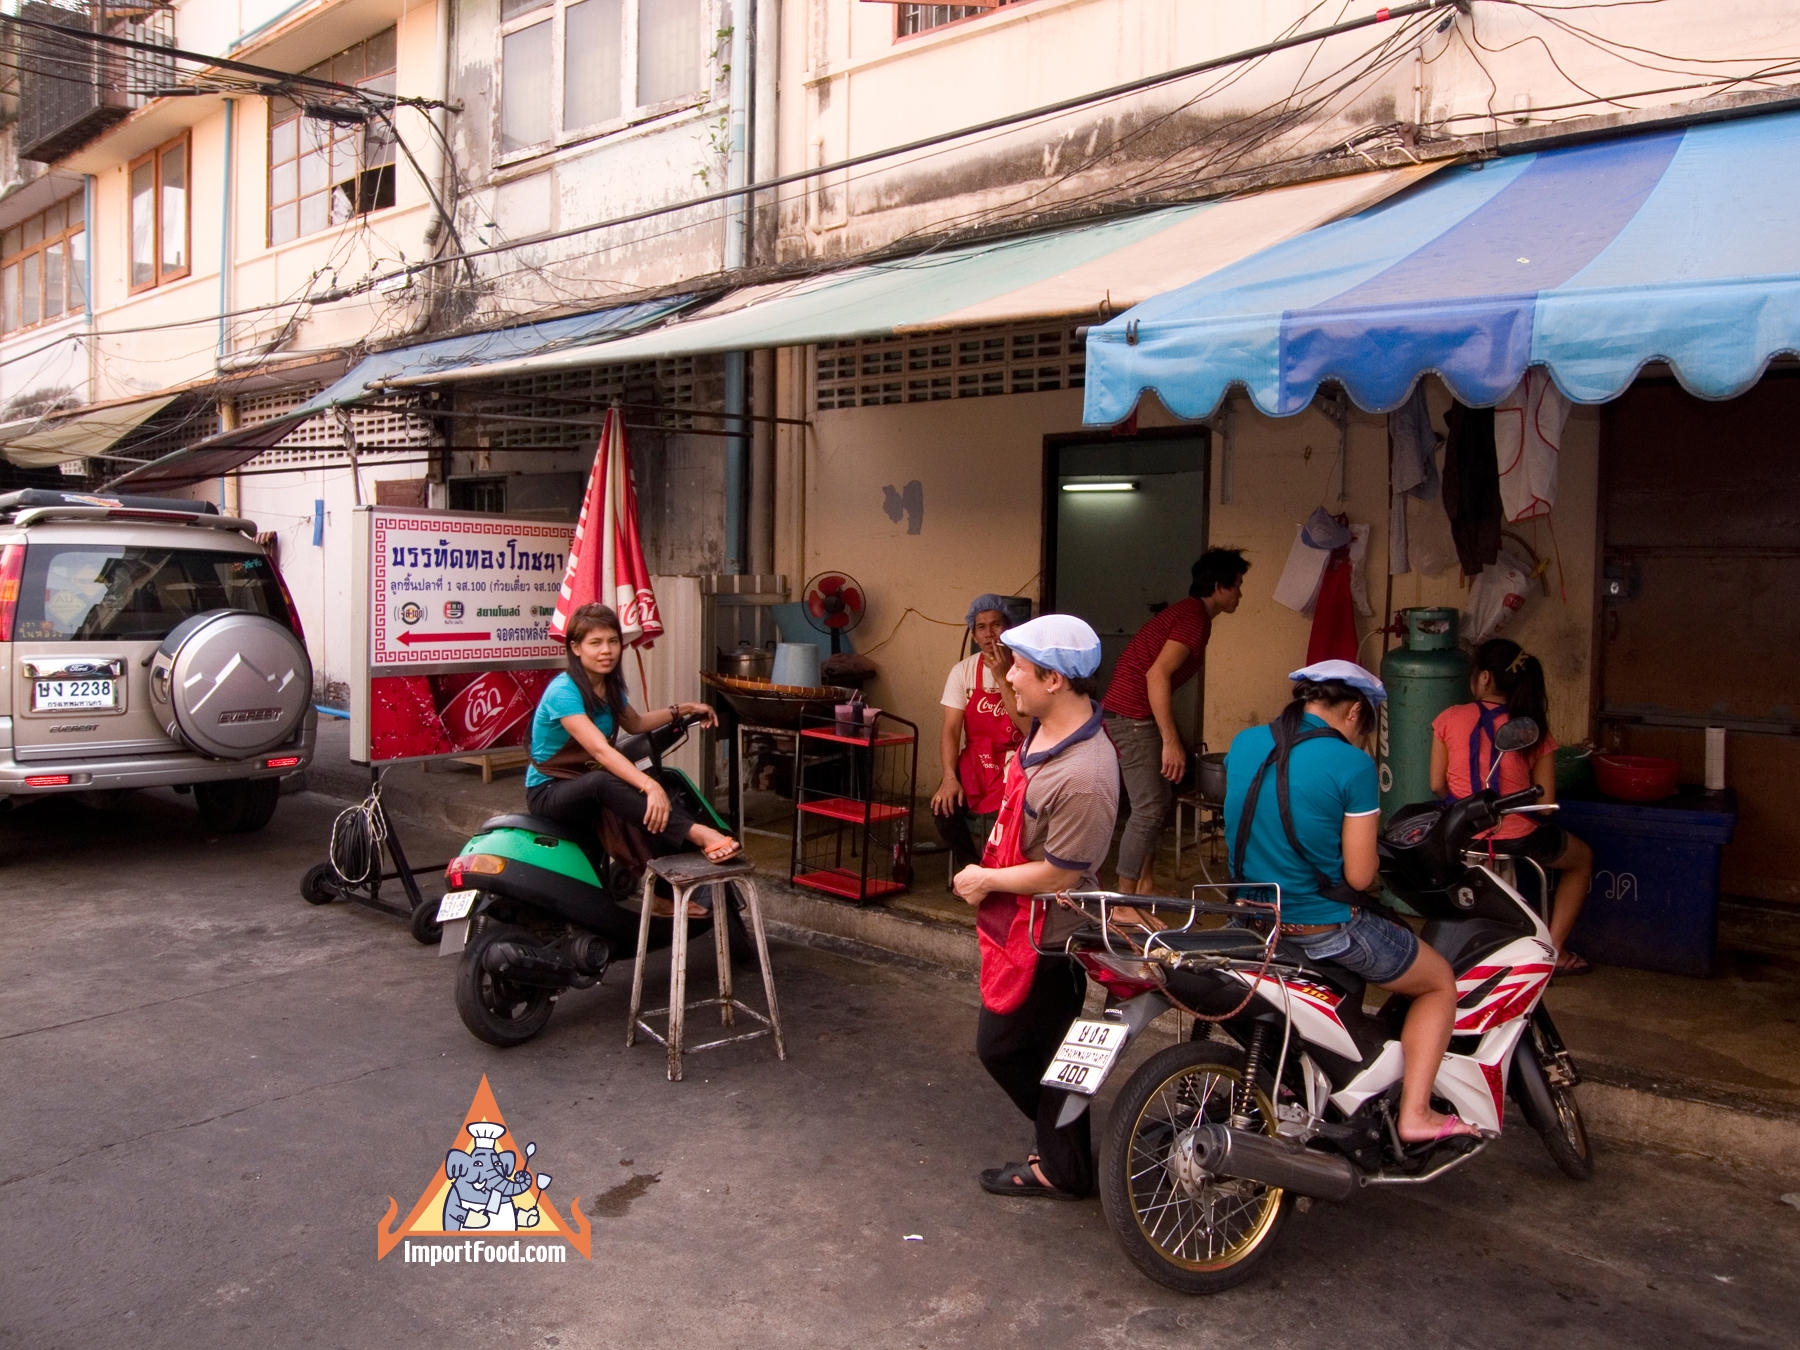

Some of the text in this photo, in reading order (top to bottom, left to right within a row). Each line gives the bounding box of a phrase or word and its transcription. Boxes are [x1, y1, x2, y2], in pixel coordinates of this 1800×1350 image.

[390, 572, 443, 595] ลูกชิ้นปลาที่
[447, 582, 452, 591] 1
[456, 580, 486, 592] จส.100
[496, 621, 551, 641] จอดรถหลังร้
[69, 664, 89, 672] Ford
[70, 681, 110, 697] 2238
[1057, 1063, 1090, 1085] 400
